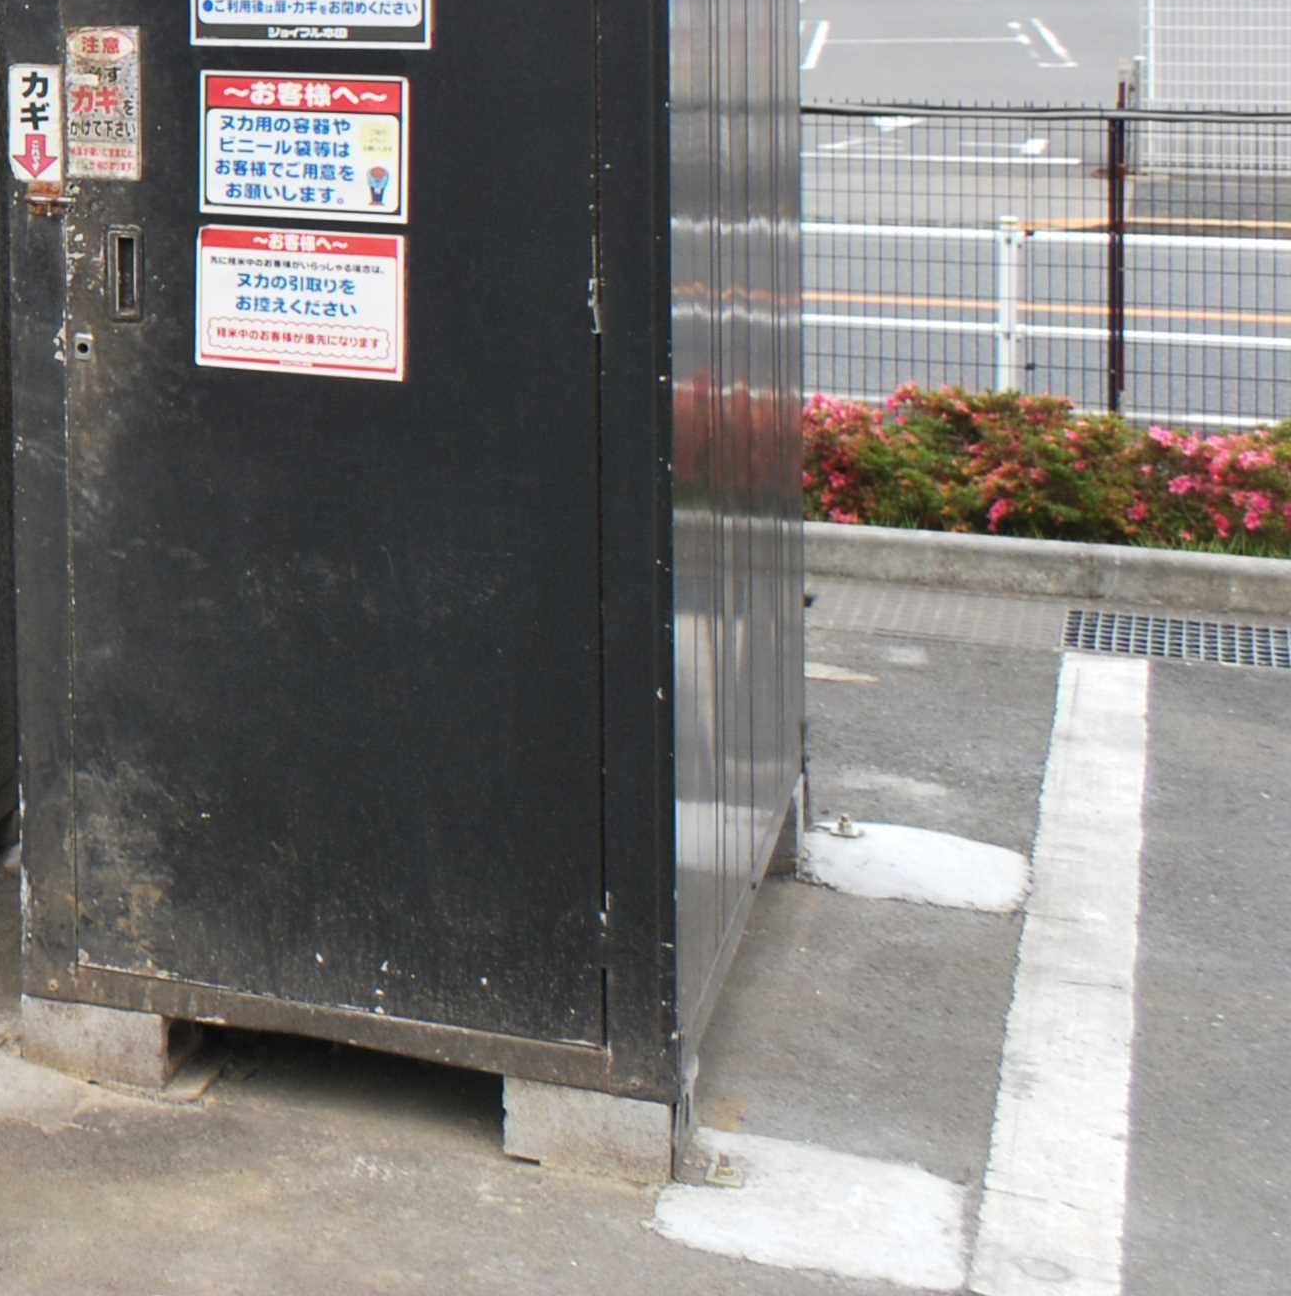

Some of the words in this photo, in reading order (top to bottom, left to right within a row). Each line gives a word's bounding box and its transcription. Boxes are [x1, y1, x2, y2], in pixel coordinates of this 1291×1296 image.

[267, 26, 348, 40] ジョイフル本田
[81, 36, 121, 54] 注意
[20, 71, 50, 131] カギ
[70, 120, 137, 138] かけて下さい
[220, 114, 352, 136] ヌカ用の容器や
[220, 137, 350, 159] ビニール袋等は
[215, 159, 356, 182] お客様でご用意を
[225, 182, 345, 205] お願いします。
[236, 272, 356, 296] ヌカの引取りを
[235, 295, 359, 318] お控えください
[216, 327, 380, 350] 精米中のお客様が優先になります
